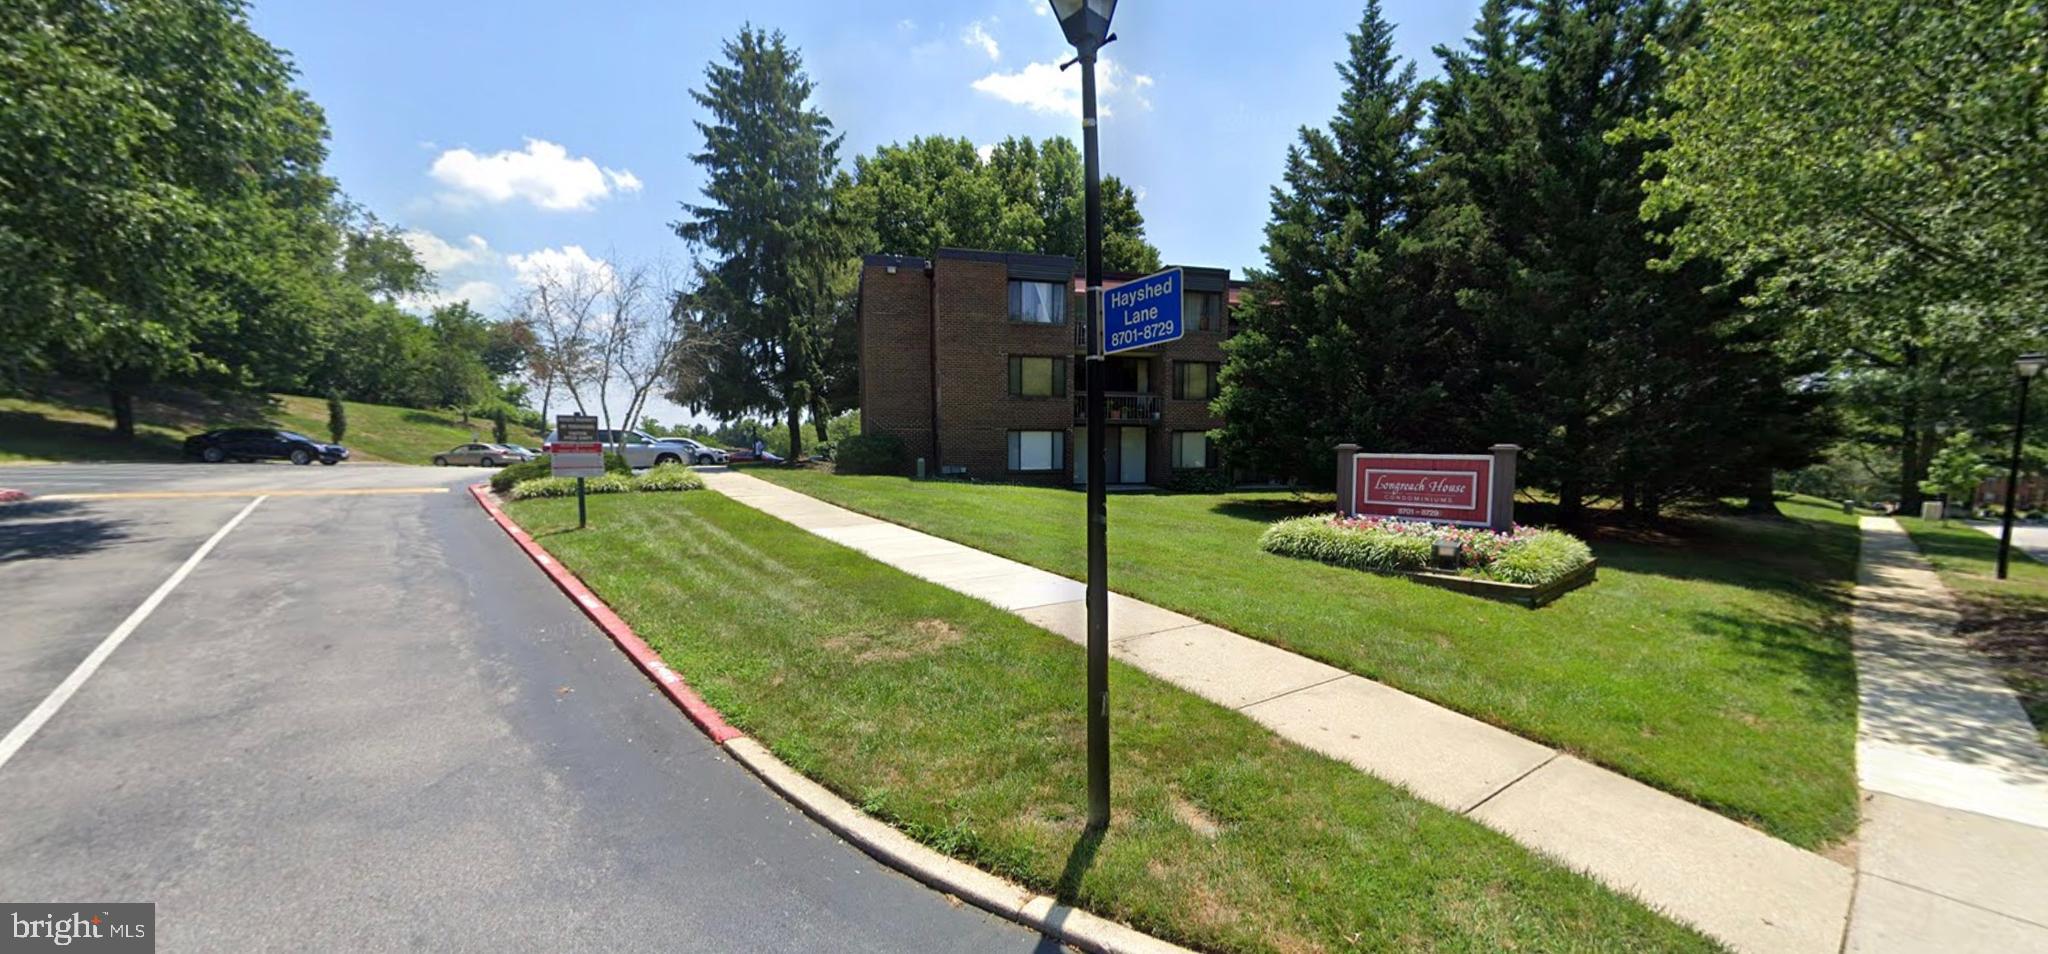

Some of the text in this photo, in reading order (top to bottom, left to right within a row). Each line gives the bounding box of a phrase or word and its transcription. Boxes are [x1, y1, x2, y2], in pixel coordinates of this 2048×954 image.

[1111, 276, 1172, 309] Hayshed
[1124, 306, 1158, 326] Lane
[1111, 320, 1174, 347] 8701-8729
[1375, 475, 1466, 495] Longreach House
[1384, 494, 1453, 503] CONDOMINIUMS
